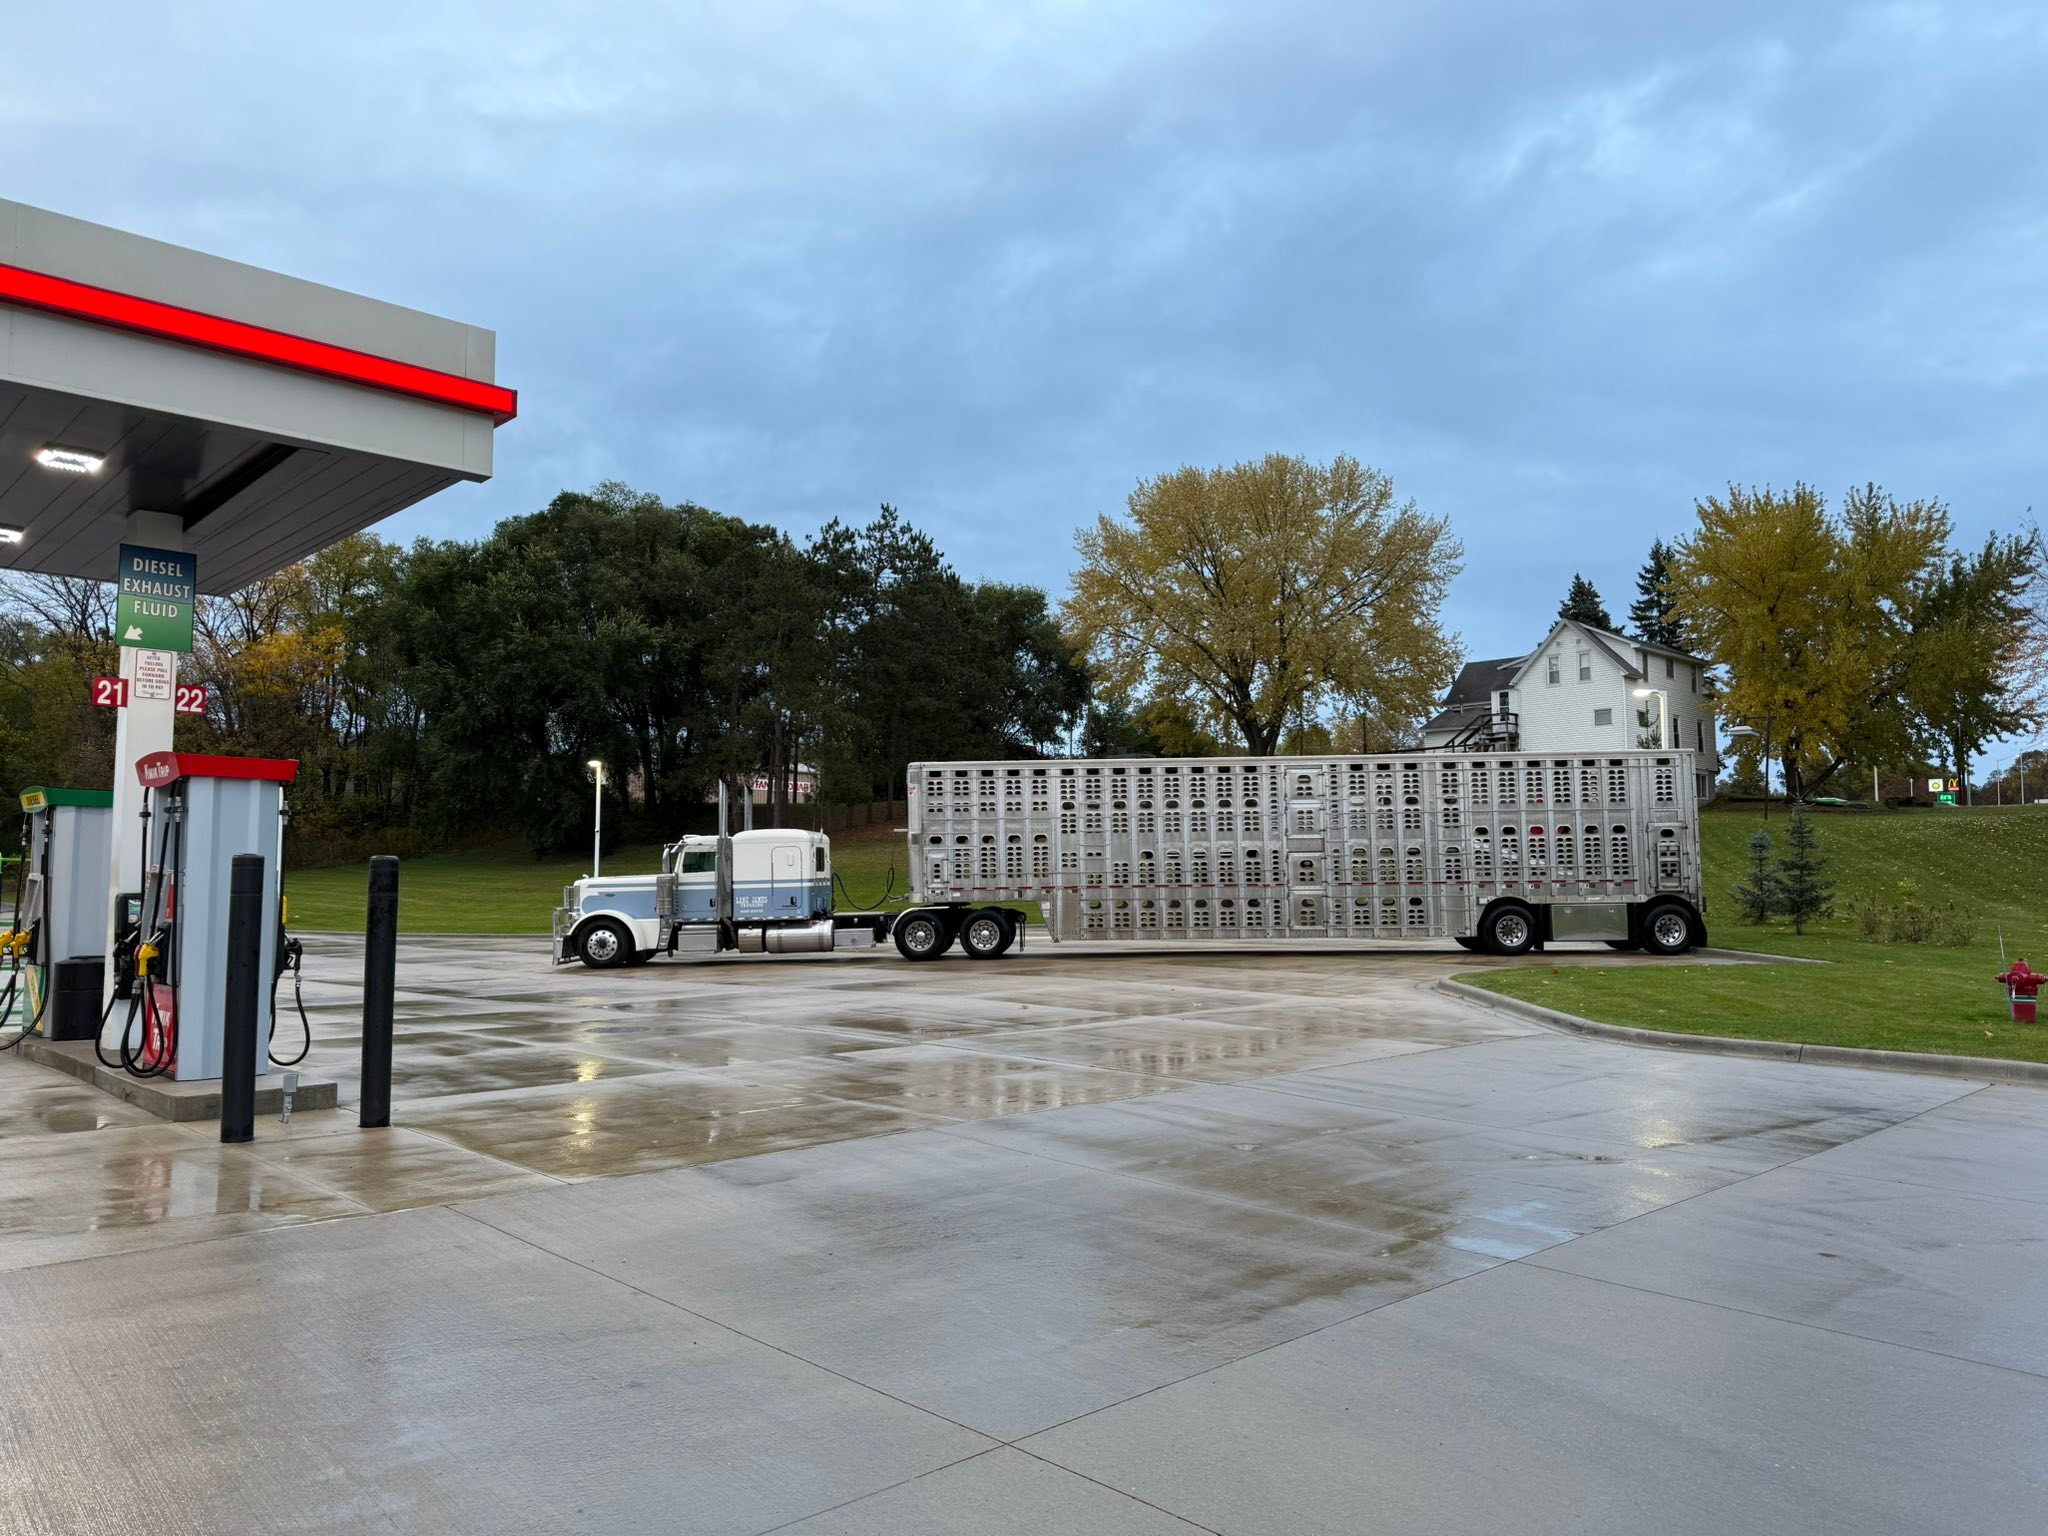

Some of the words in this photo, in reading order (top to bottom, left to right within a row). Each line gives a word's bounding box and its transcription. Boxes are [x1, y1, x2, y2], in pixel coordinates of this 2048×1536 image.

[133, 557, 183, 577] DIESEL
[123, 577, 191, 599] EXHAUST
[133, 600, 178, 618] FLUID
[97, 680, 123, 705] 21
[176, 687, 203, 712] 22
